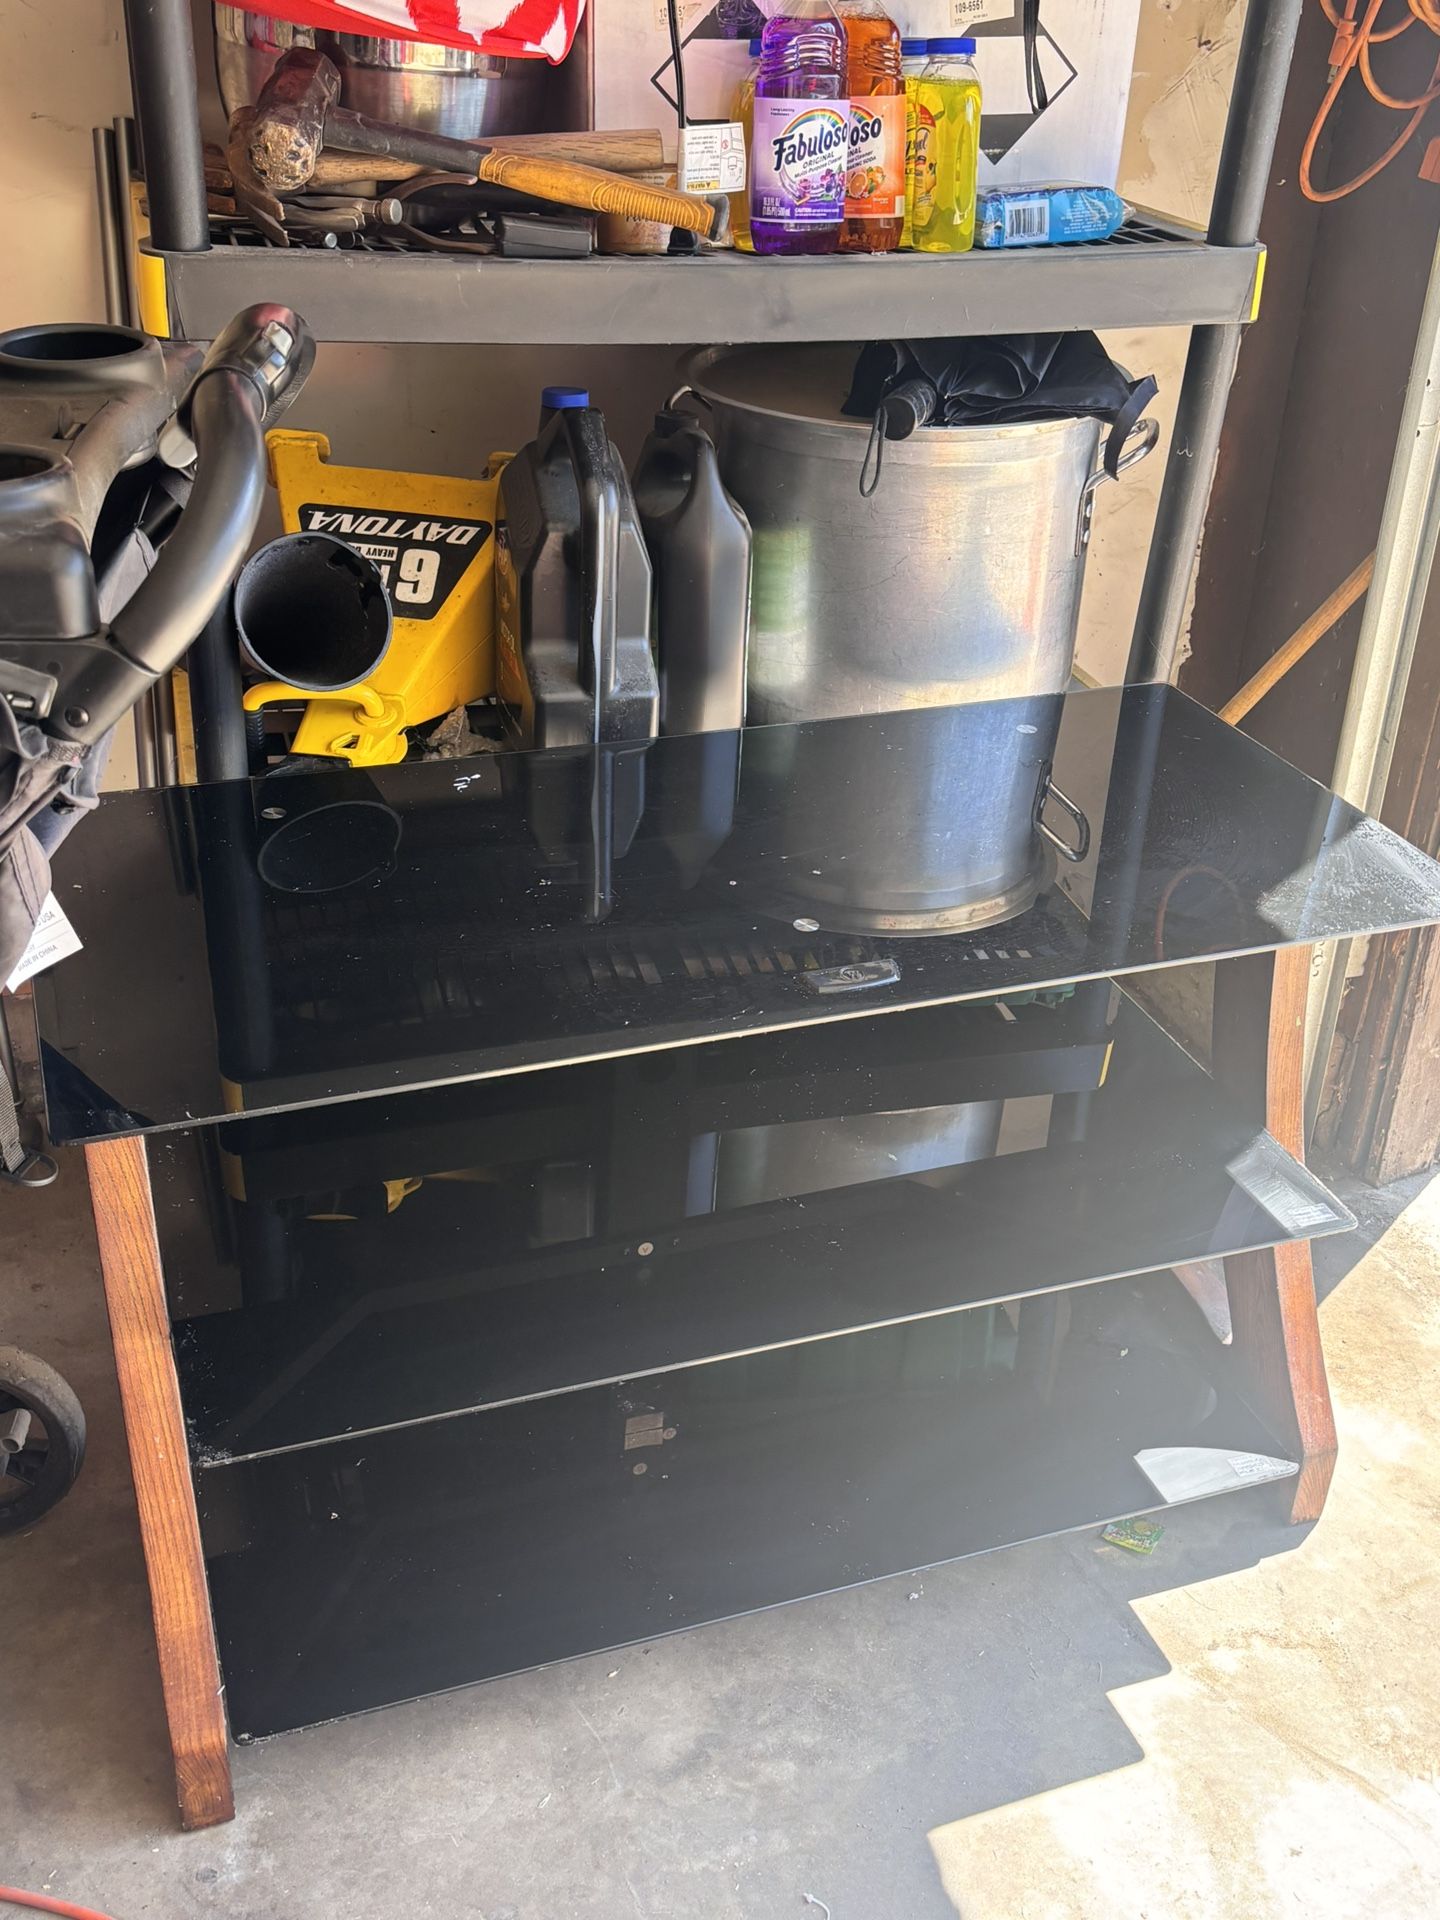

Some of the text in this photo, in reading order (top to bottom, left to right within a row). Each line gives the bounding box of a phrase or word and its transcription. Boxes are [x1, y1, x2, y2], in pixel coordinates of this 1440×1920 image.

[772, 122, 848, 171] Fabuloso
[802, 151, 834, 169] ORIGINAL
[307, 510, 481, 546] DAYTONA
[366, 546, 396, 559] HEAVY
[394, 548, 441, 604] 6
[41, 911, 56, 924] USA
[39, 944, 58, 959] CHINA
